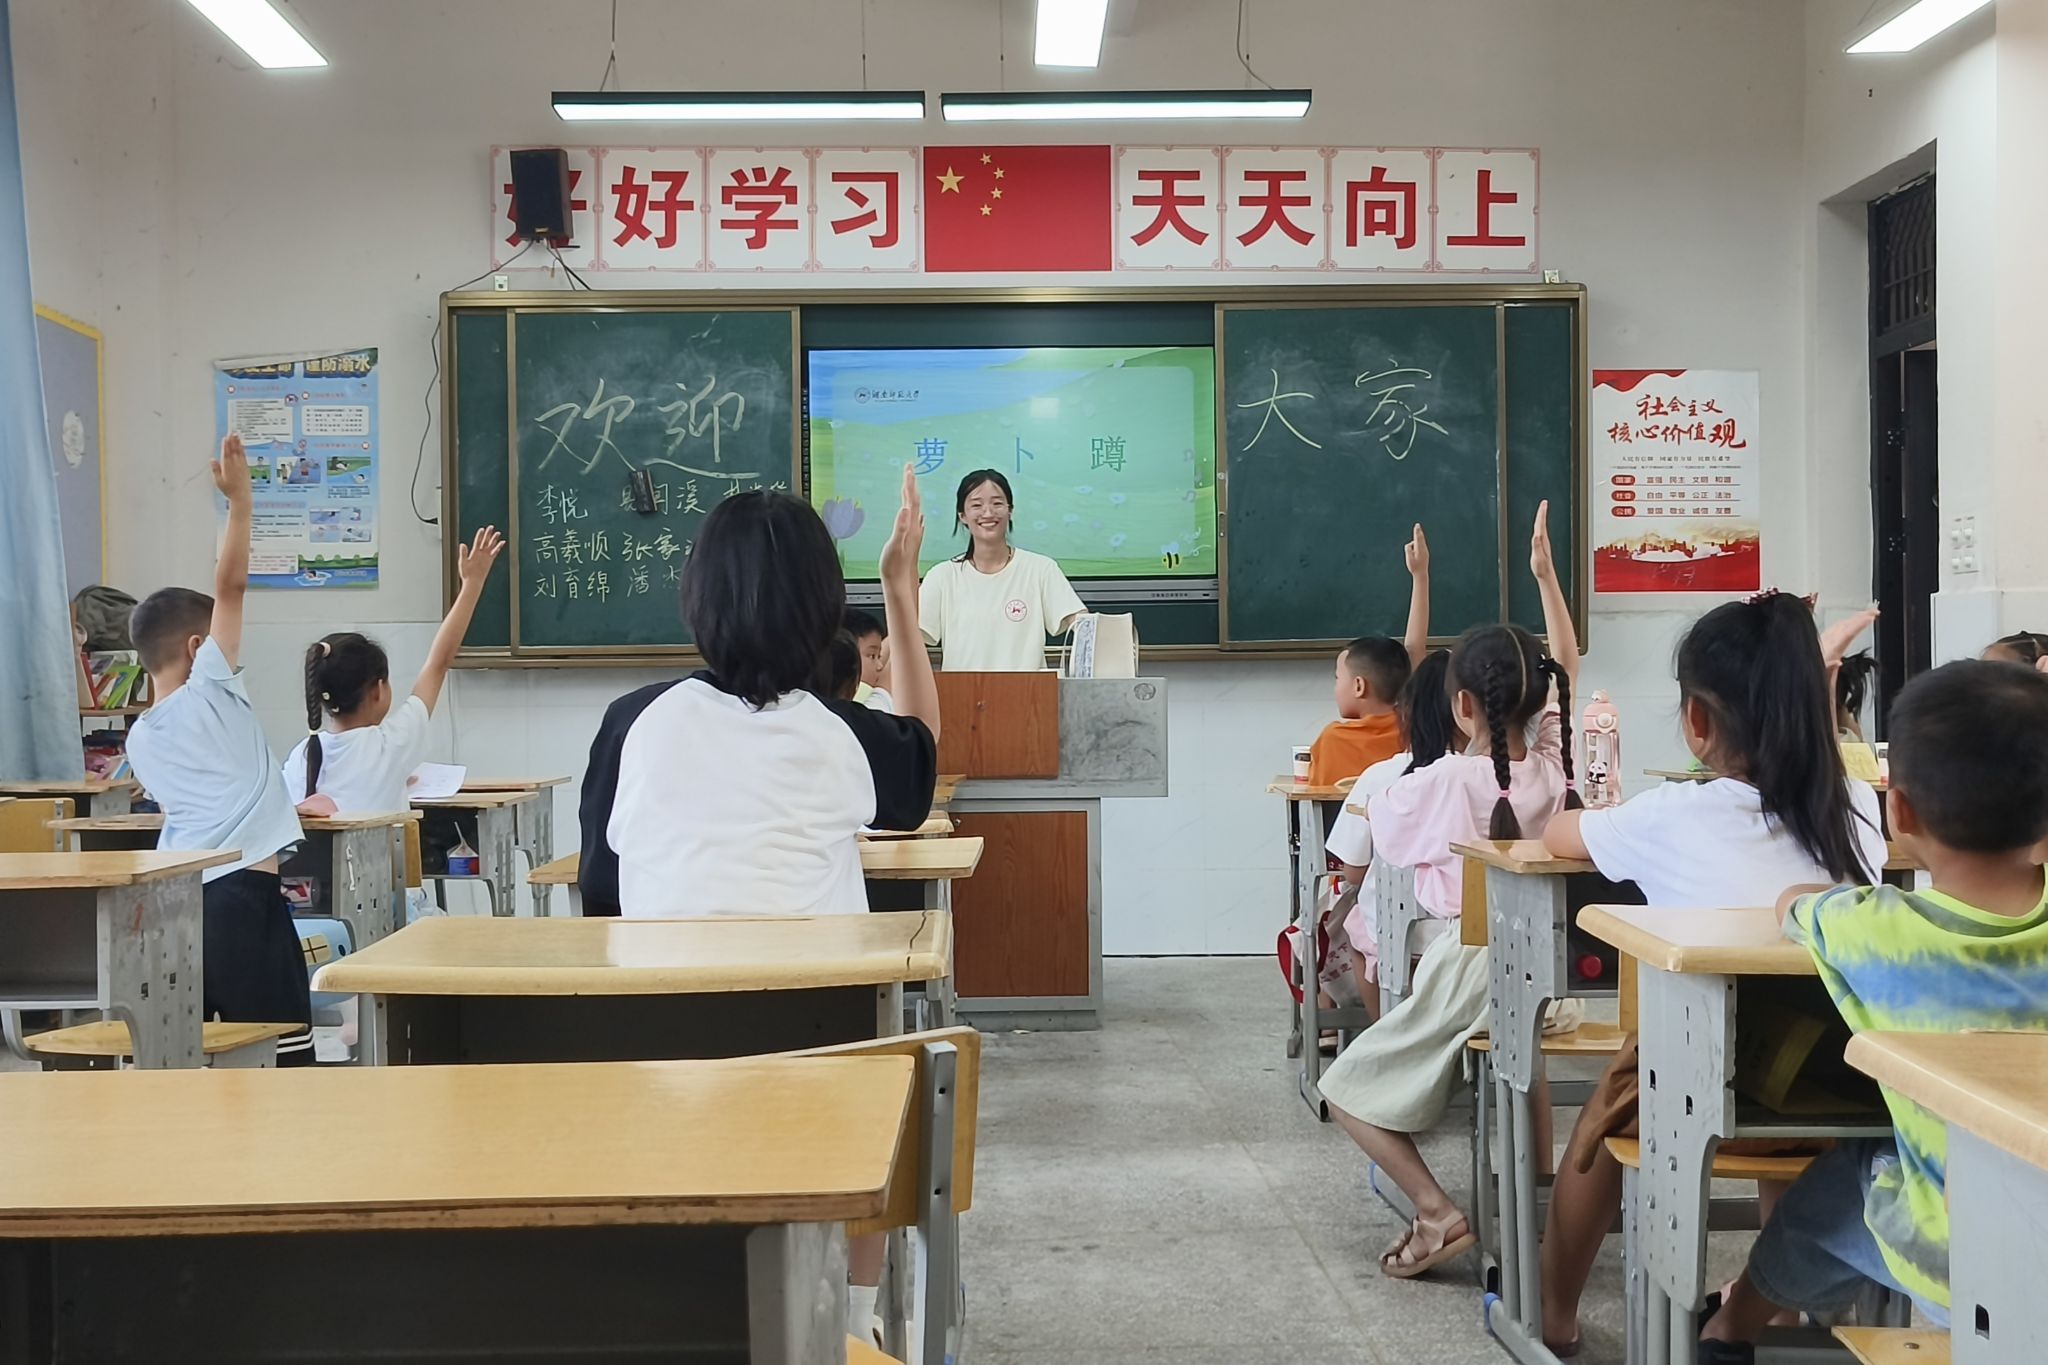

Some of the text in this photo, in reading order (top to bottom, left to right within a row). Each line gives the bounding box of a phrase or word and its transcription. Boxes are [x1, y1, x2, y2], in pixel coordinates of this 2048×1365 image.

[1130, 165, 1526, 250] 天天向上
[534, 375, 761, 479] 欢迎
[1237, 355, 1449, 460] 大家
[1607, 418, 1747, 449] 核心价值观
[1636, 394, 1723, 421] 社会主义
